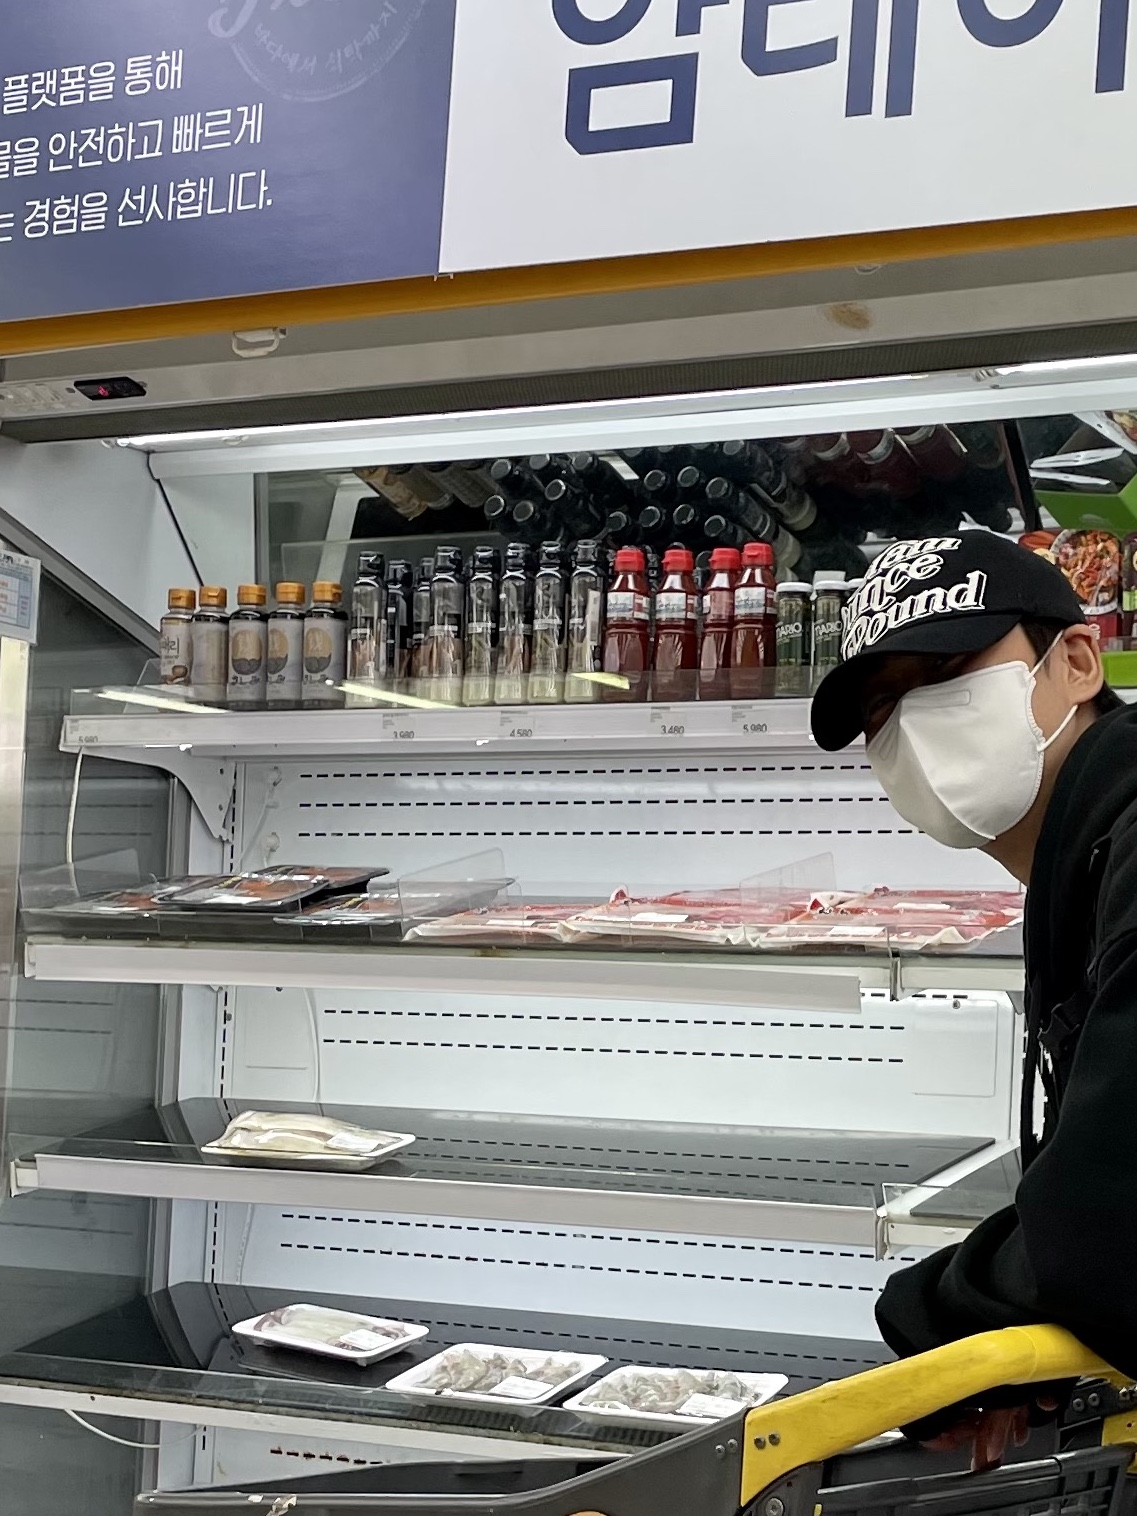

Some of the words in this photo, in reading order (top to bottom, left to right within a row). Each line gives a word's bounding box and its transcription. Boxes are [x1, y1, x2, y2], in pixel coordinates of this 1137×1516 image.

[2, 61, 116, 115] 플랫폼을
[124, 49, 183, 96] 통해
[48, 119, 163, 172] 안전하고
[171, 103, 264, 153] 빠르게
[23, 191, 108, 239] 경험을
[117, 169, 274, 227] 선사합니다.
